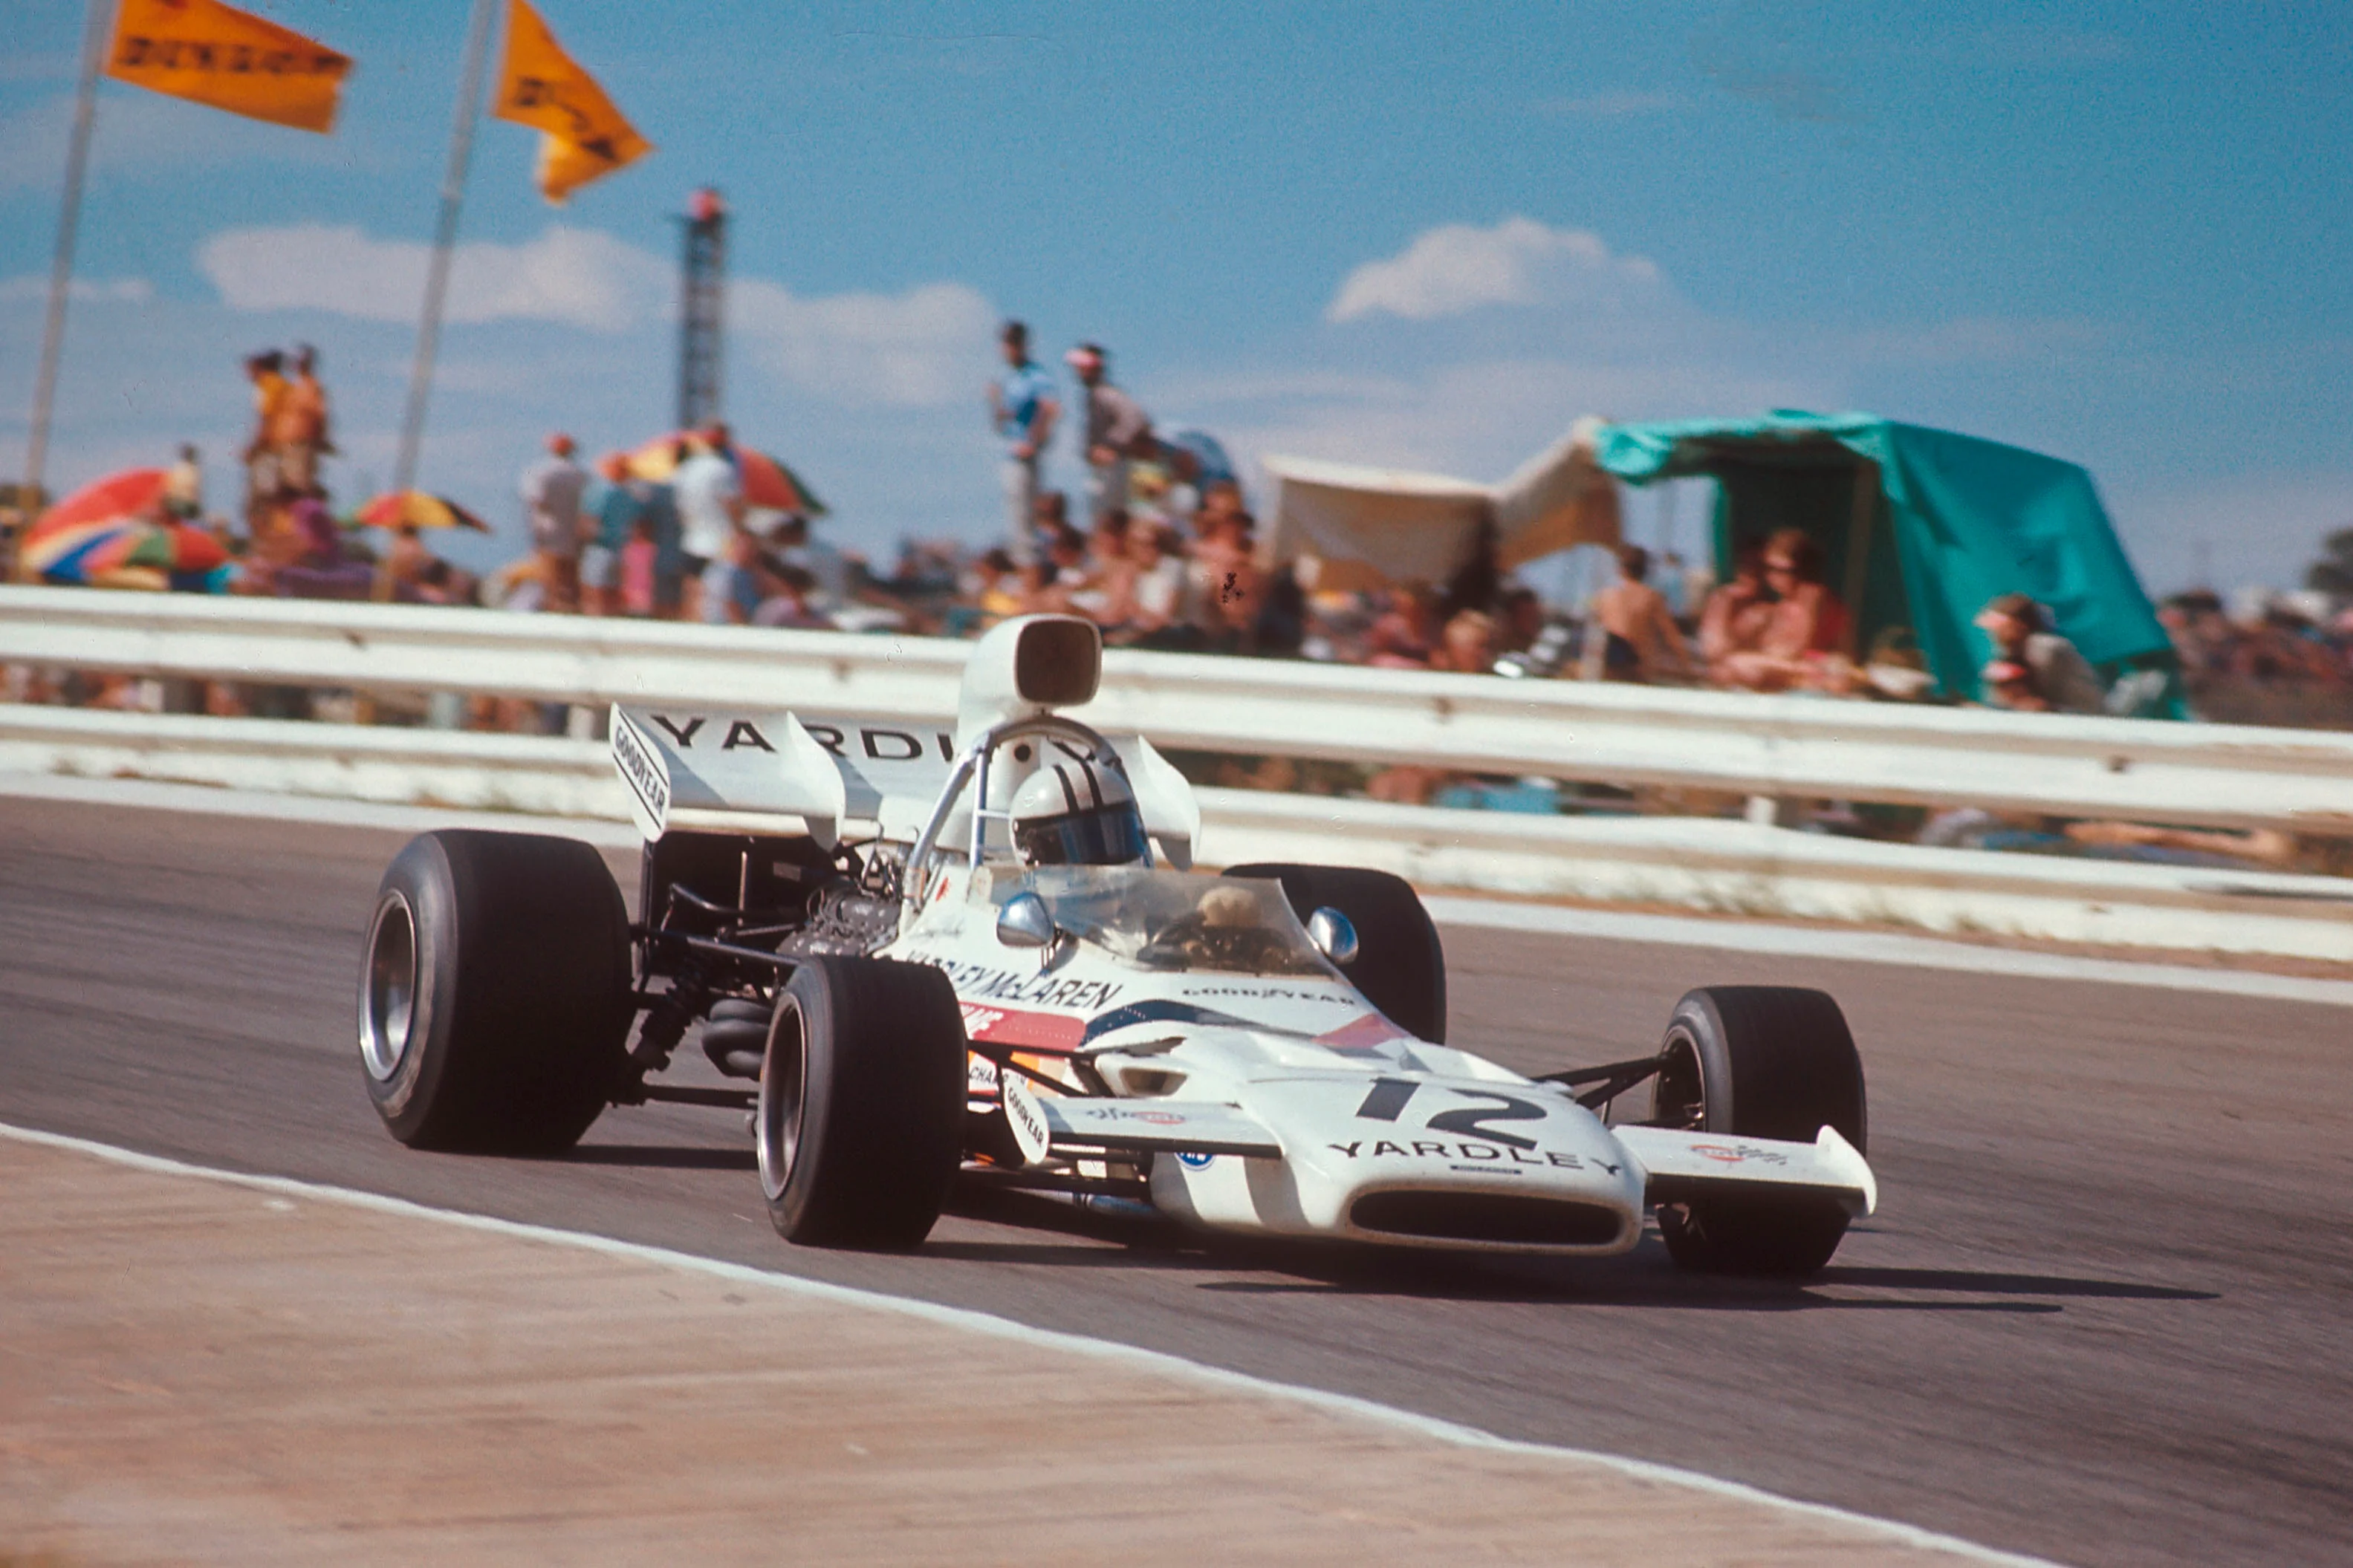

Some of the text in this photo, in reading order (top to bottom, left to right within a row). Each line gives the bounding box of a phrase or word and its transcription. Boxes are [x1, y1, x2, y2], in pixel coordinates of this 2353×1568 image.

[616, 725, 666, 815] GOODYEAR
[1008, 1087, 1044, 1147] GOODYEAR
[1356, 1077, 1548, 1151] 12
[1328, 1141, 1621, 1176] YARDLEY
